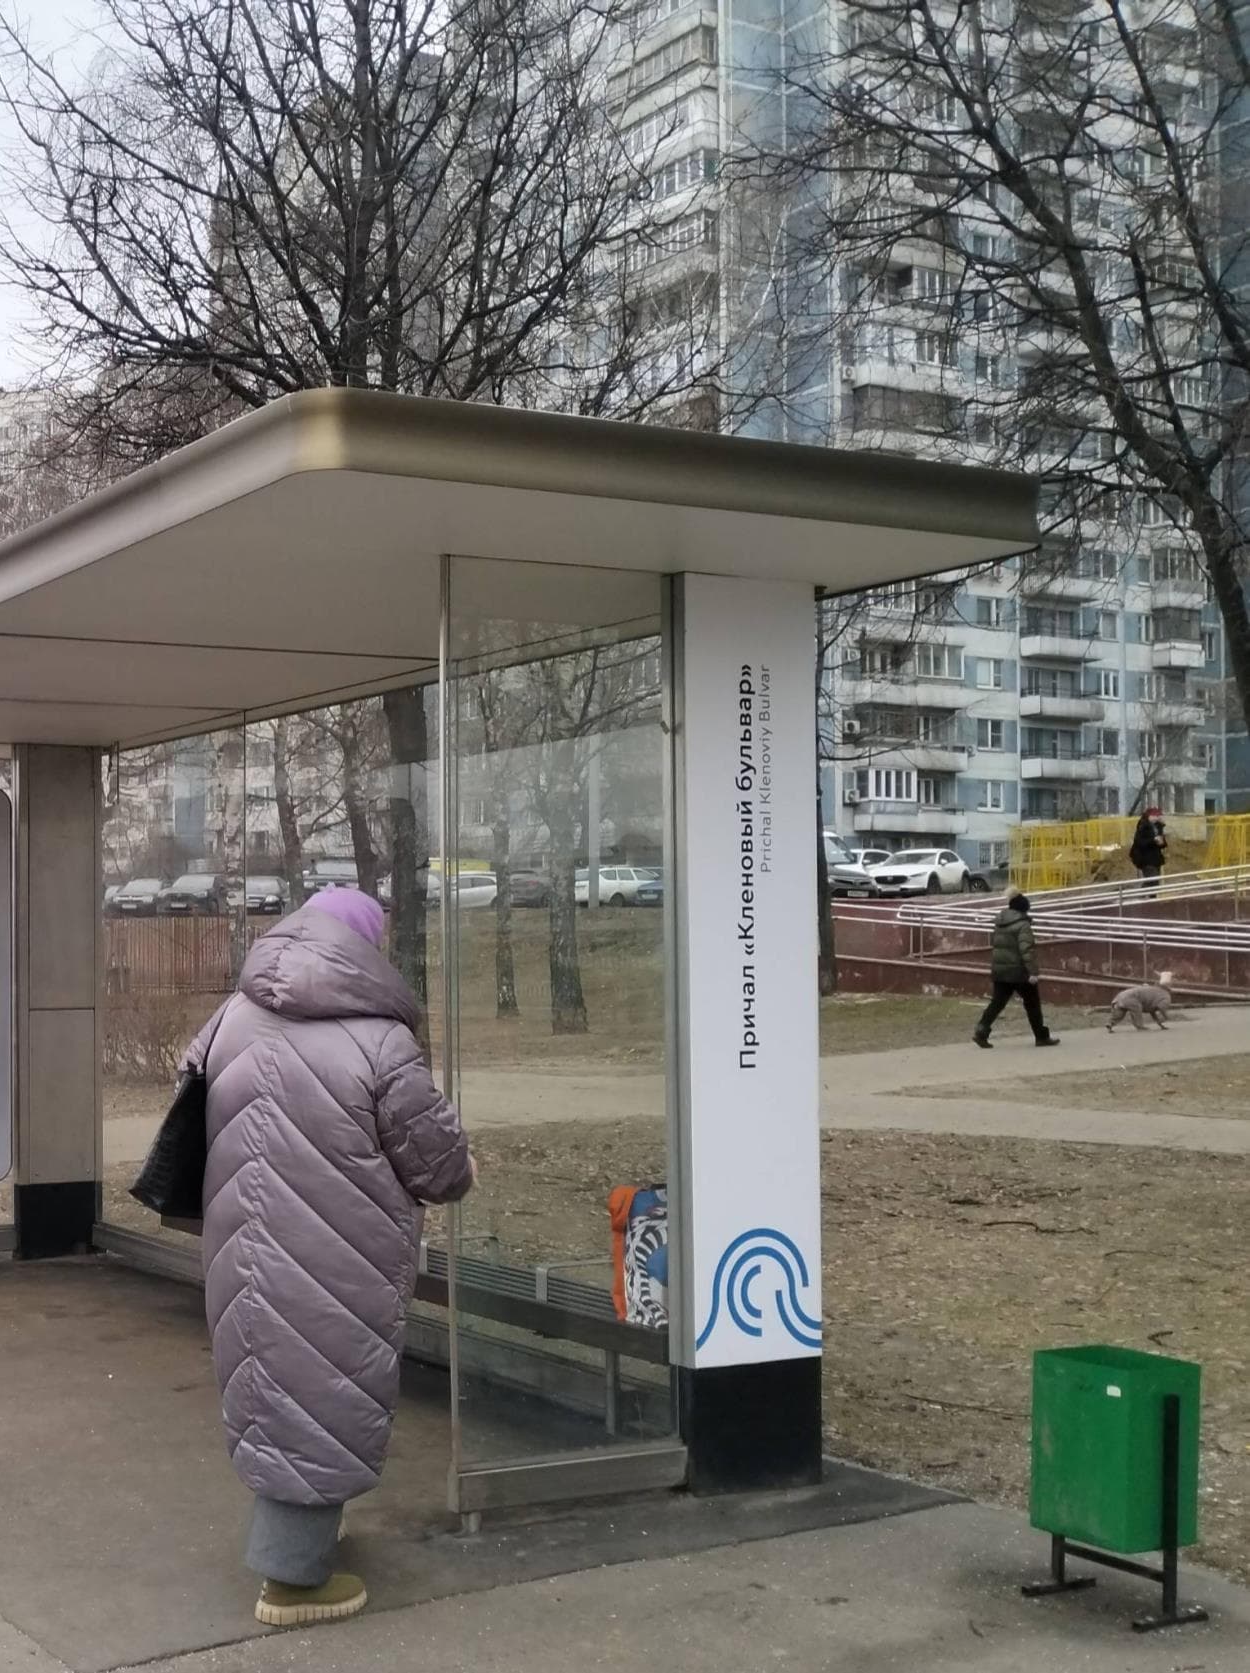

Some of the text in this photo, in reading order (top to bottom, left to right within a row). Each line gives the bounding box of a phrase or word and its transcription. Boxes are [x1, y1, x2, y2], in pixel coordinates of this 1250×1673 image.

[735, 663, 759, 1069] Причал «Кленовый бульвар»
[758, 664, 773, 873] Prichal Klenoviy Bulvar
